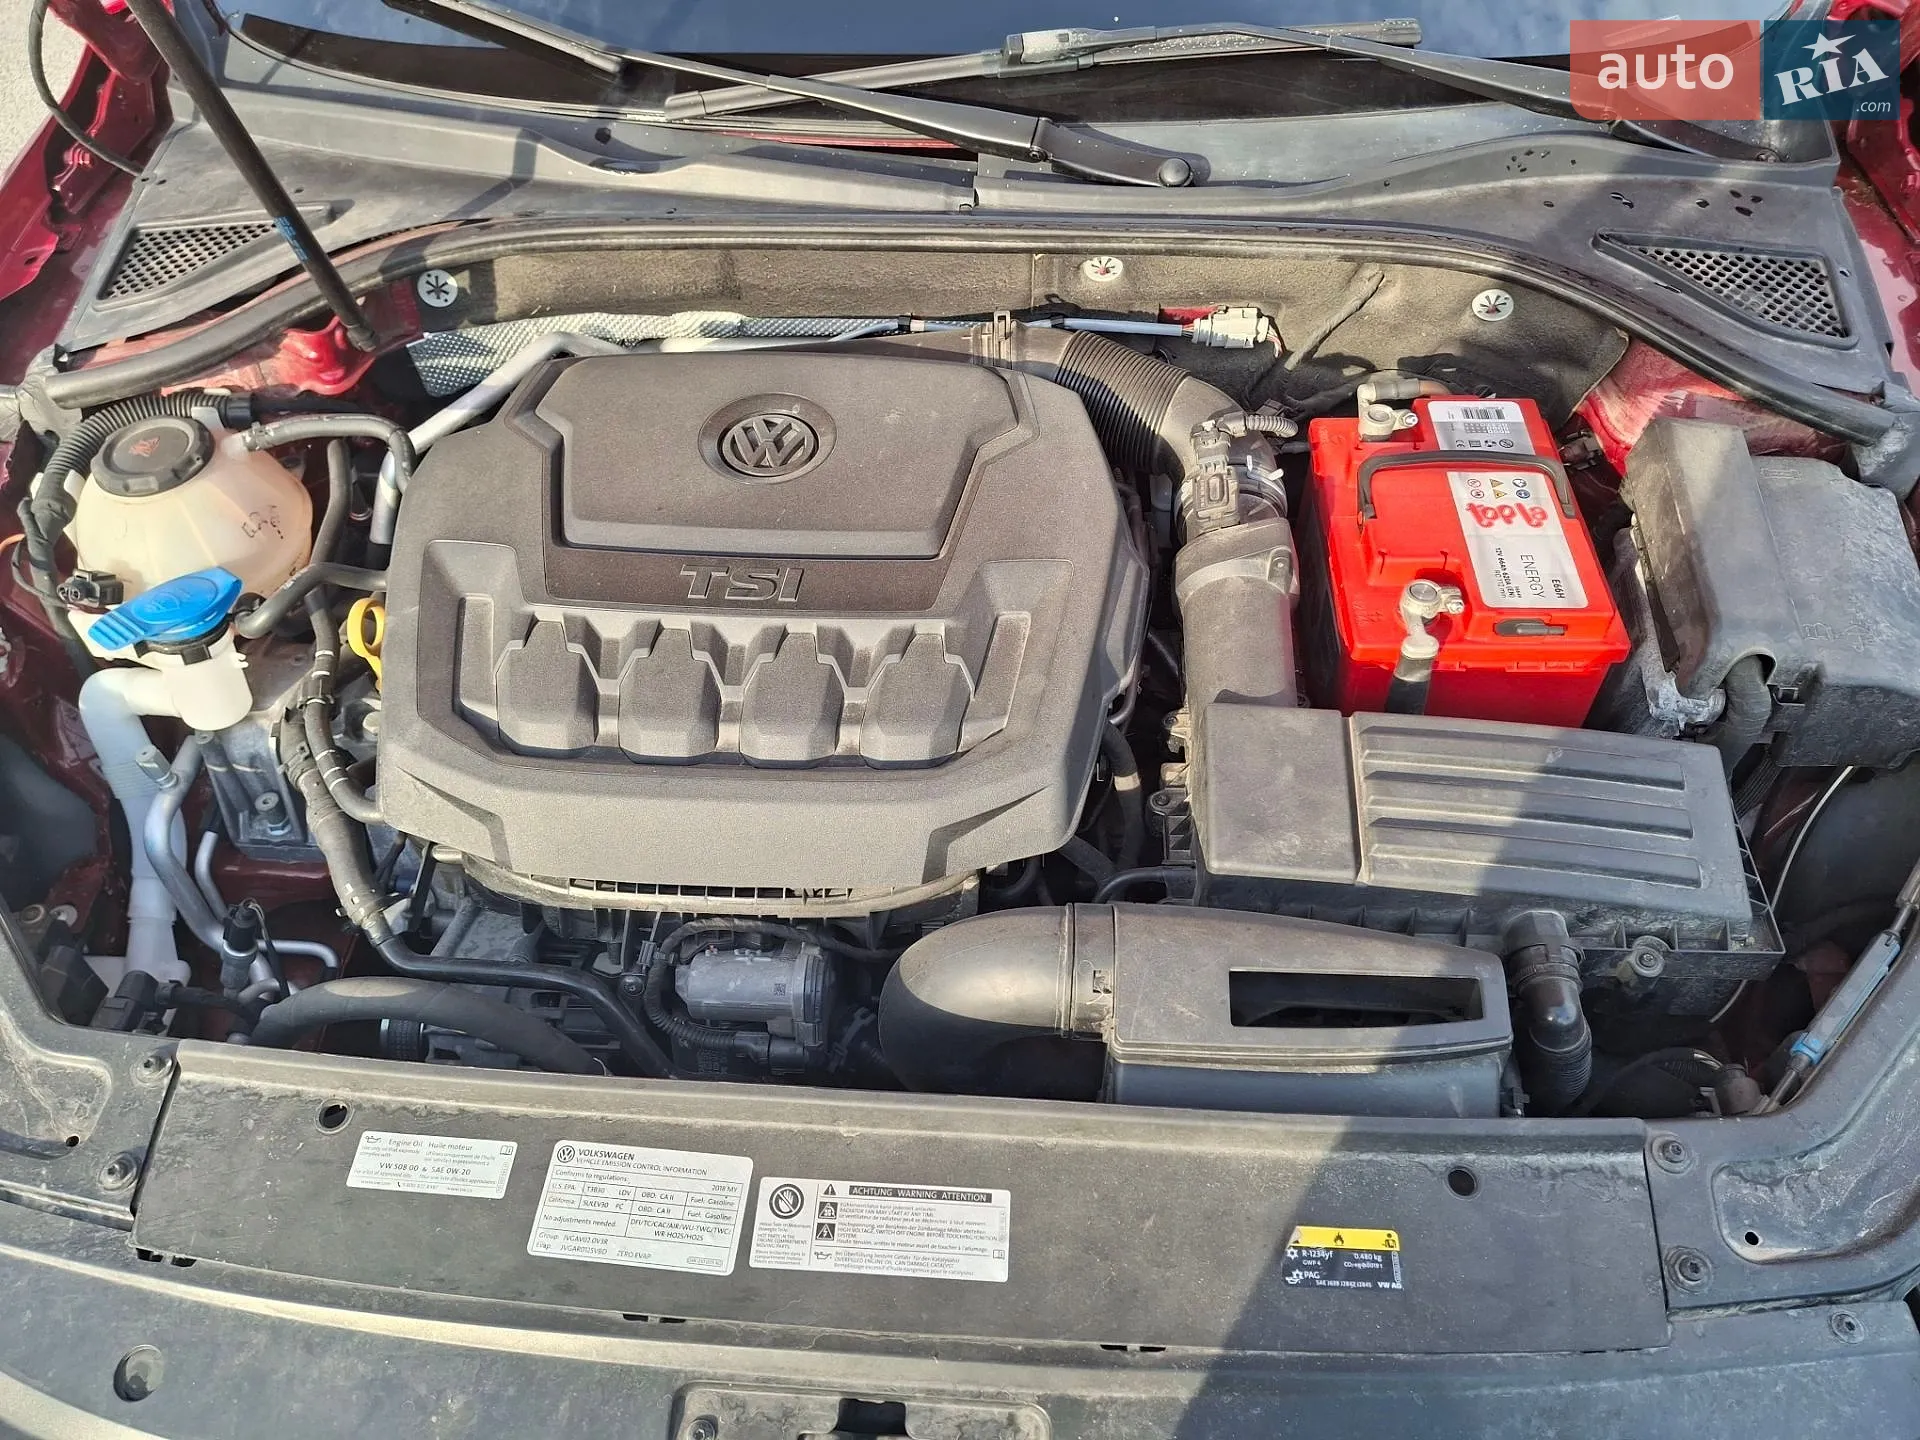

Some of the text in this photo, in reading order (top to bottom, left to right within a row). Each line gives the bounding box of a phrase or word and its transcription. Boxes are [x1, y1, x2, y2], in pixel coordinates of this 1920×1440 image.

[1520, 554, 1545, 598] ENERGY
[680, 564, 804, 602] TSI
[1551, 579, 1566, 599] E66H
[387, 1138, 412, 1147] Engine
[427, 1141, 446, 1149] Huile
[446, 1142, 473, 1151] moteur
[577, 1148, 635, 1160] VOLKSWAGEN
[575, 1157, 707, 1175] VEHICLE EMISSION CONTROL INFORMATION
[554, 1169, 584, 1178] Conforms
[852, 1186, 986, 1201] ACHTUNG WARNING ATTENTION
[707, 1198, 735, 1206] Gasoline
[552, 1215, 591, 1225] adjustments
[704, 1211, 732, 1220] Gasoline
[1300, 1249, 1333, 1260] R-1234yf
[1303, 1271, 1320, 1279] PAG
